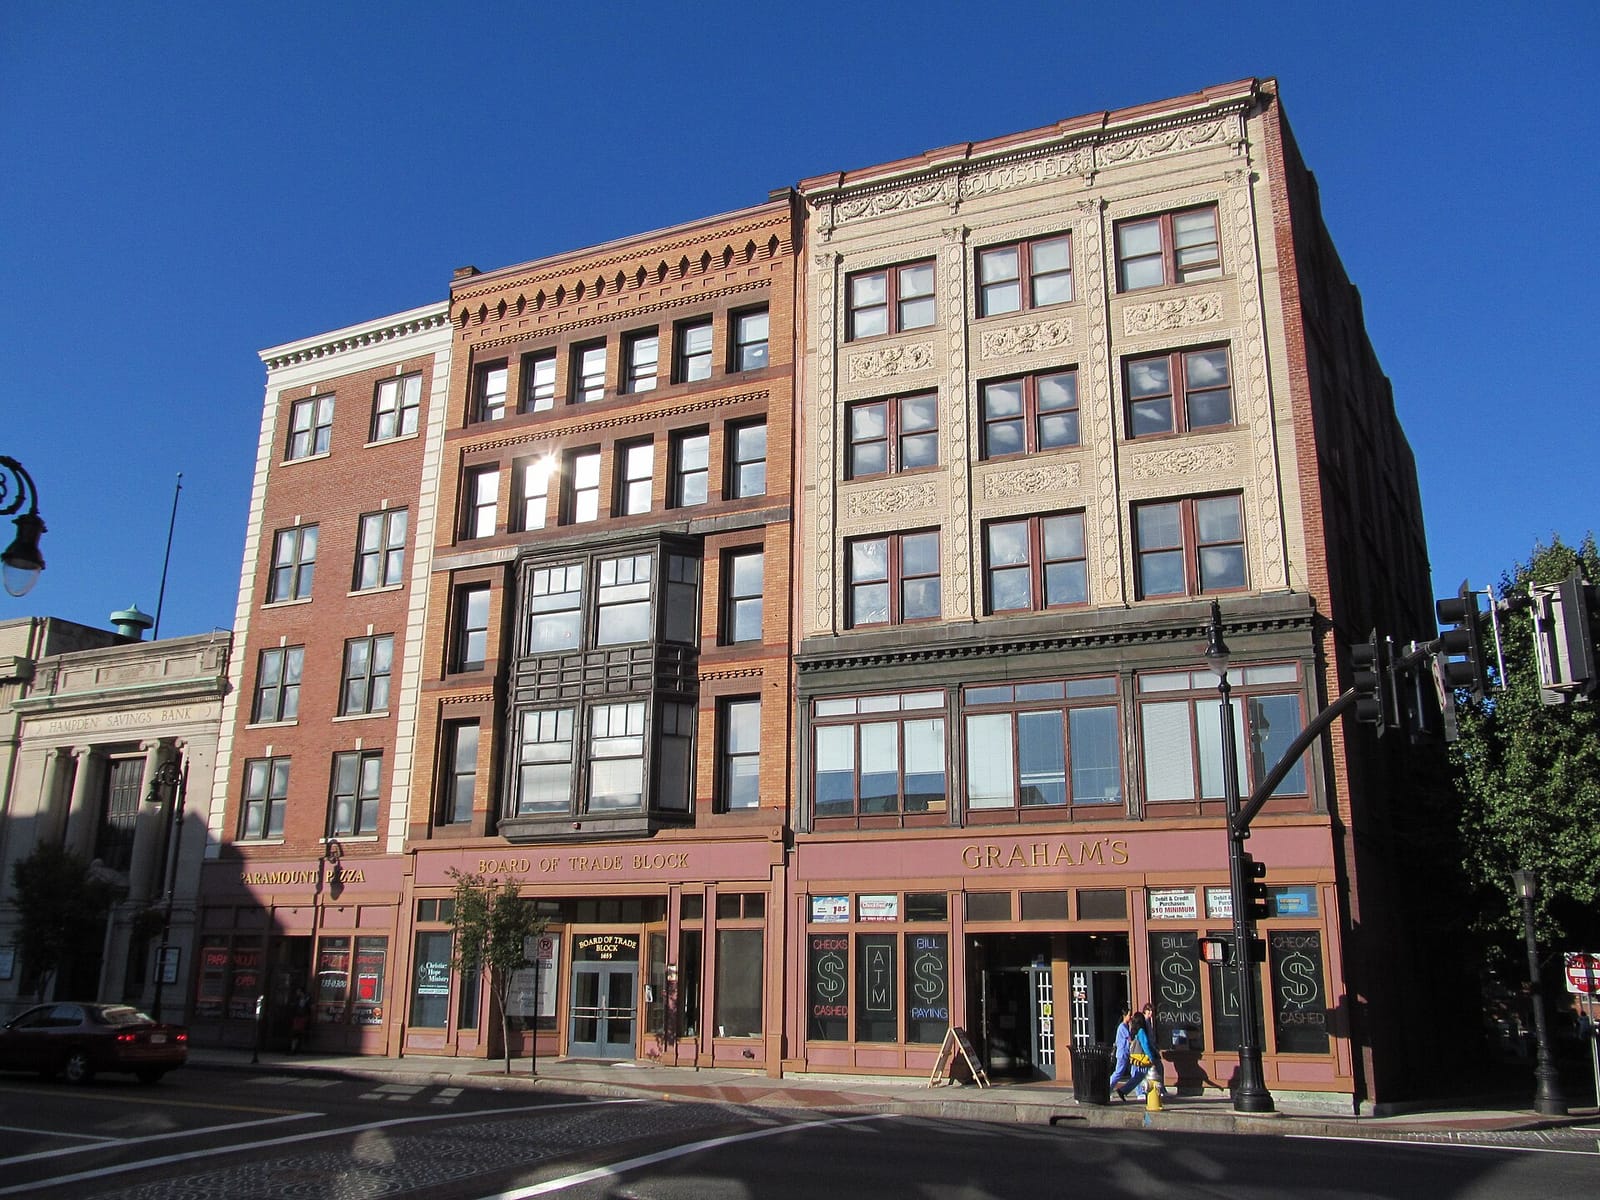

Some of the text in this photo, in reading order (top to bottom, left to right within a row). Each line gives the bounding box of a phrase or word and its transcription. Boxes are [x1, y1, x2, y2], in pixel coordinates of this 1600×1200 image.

[969, 156, 1072, 195] OLMSTED
[49, 707, 192, 733] HAMPDEN SAVINGS BANK
[961, 838, 1129, 869] GRAHAM'S
[478, 853, 689, 874] BOARD OF TRADE BLOCK
[240, 869, 365, 884] PARAMOUNT PZZA
[579, 936, 637, 949] BOARD OF TRADE
[813, 939, 848, 950] CHECKS
[916, 938, 940, 949] BILL
[1161, 937, 1188, 949] BILL
[1273, 936, 1319, 949] CHECKS
[872, 950, 886, 1003] ATM
[814, 1005, 848, 1016] CASHED
[911, 1008, 948, 1019] PAYING
[1158, 1011, 1201, 1024] PAYING
[1280, 1012, 1325, 1024] CASHED
